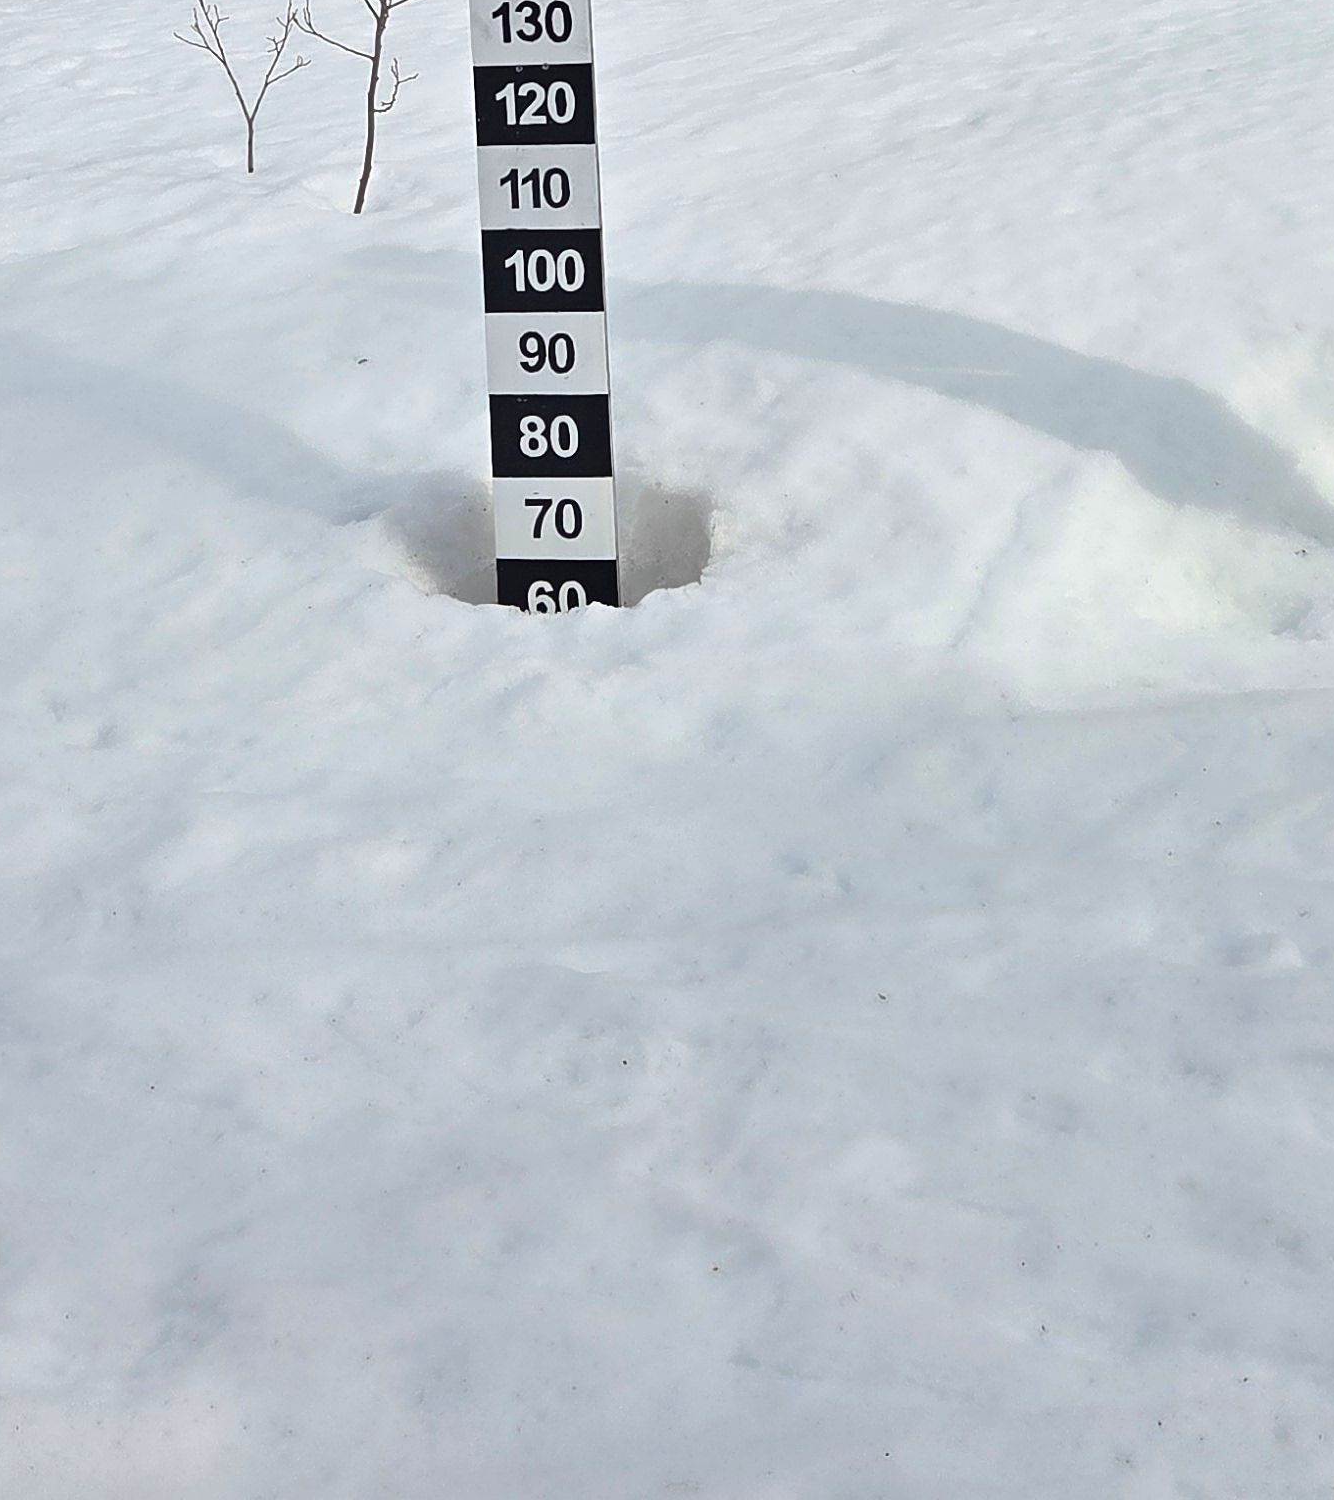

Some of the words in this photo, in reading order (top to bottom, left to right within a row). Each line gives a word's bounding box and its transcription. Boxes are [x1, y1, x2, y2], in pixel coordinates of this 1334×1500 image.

[491, 0, 572, 44] 130
[494, 80, 575, 126] 120
[499, 166, 571, 210] 110
[504, 248, 585, 293] 100
[519, 330, 575, 375] 90
[519, 415, 579, 458] 80
[524, 498, 583, 540] 70
[528, 580, 587, 614] 60
